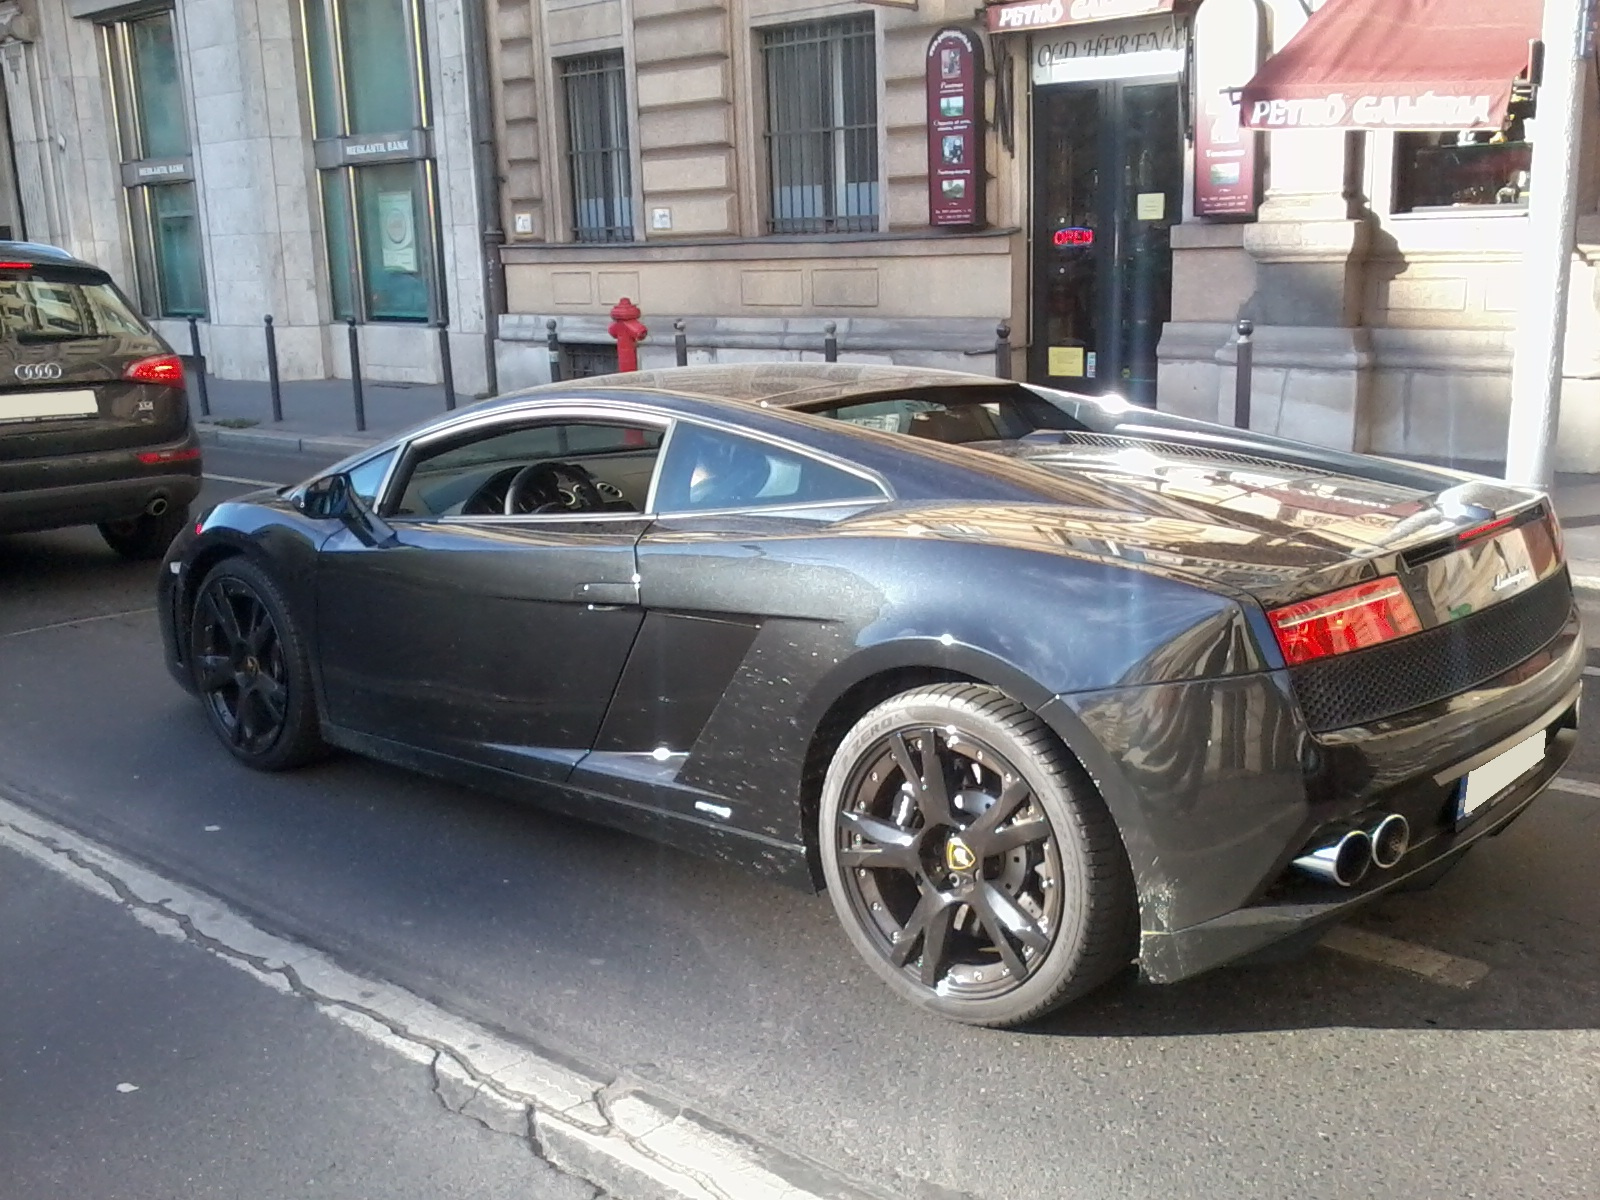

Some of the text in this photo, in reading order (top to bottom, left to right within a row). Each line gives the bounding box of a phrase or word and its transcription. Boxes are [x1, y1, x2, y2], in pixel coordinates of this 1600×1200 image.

[1037, 39, 1078, 67] OLD
[1250, 93, 1346, 126] PETRÓ
[1053, 229, 1093, 246] OPEN
